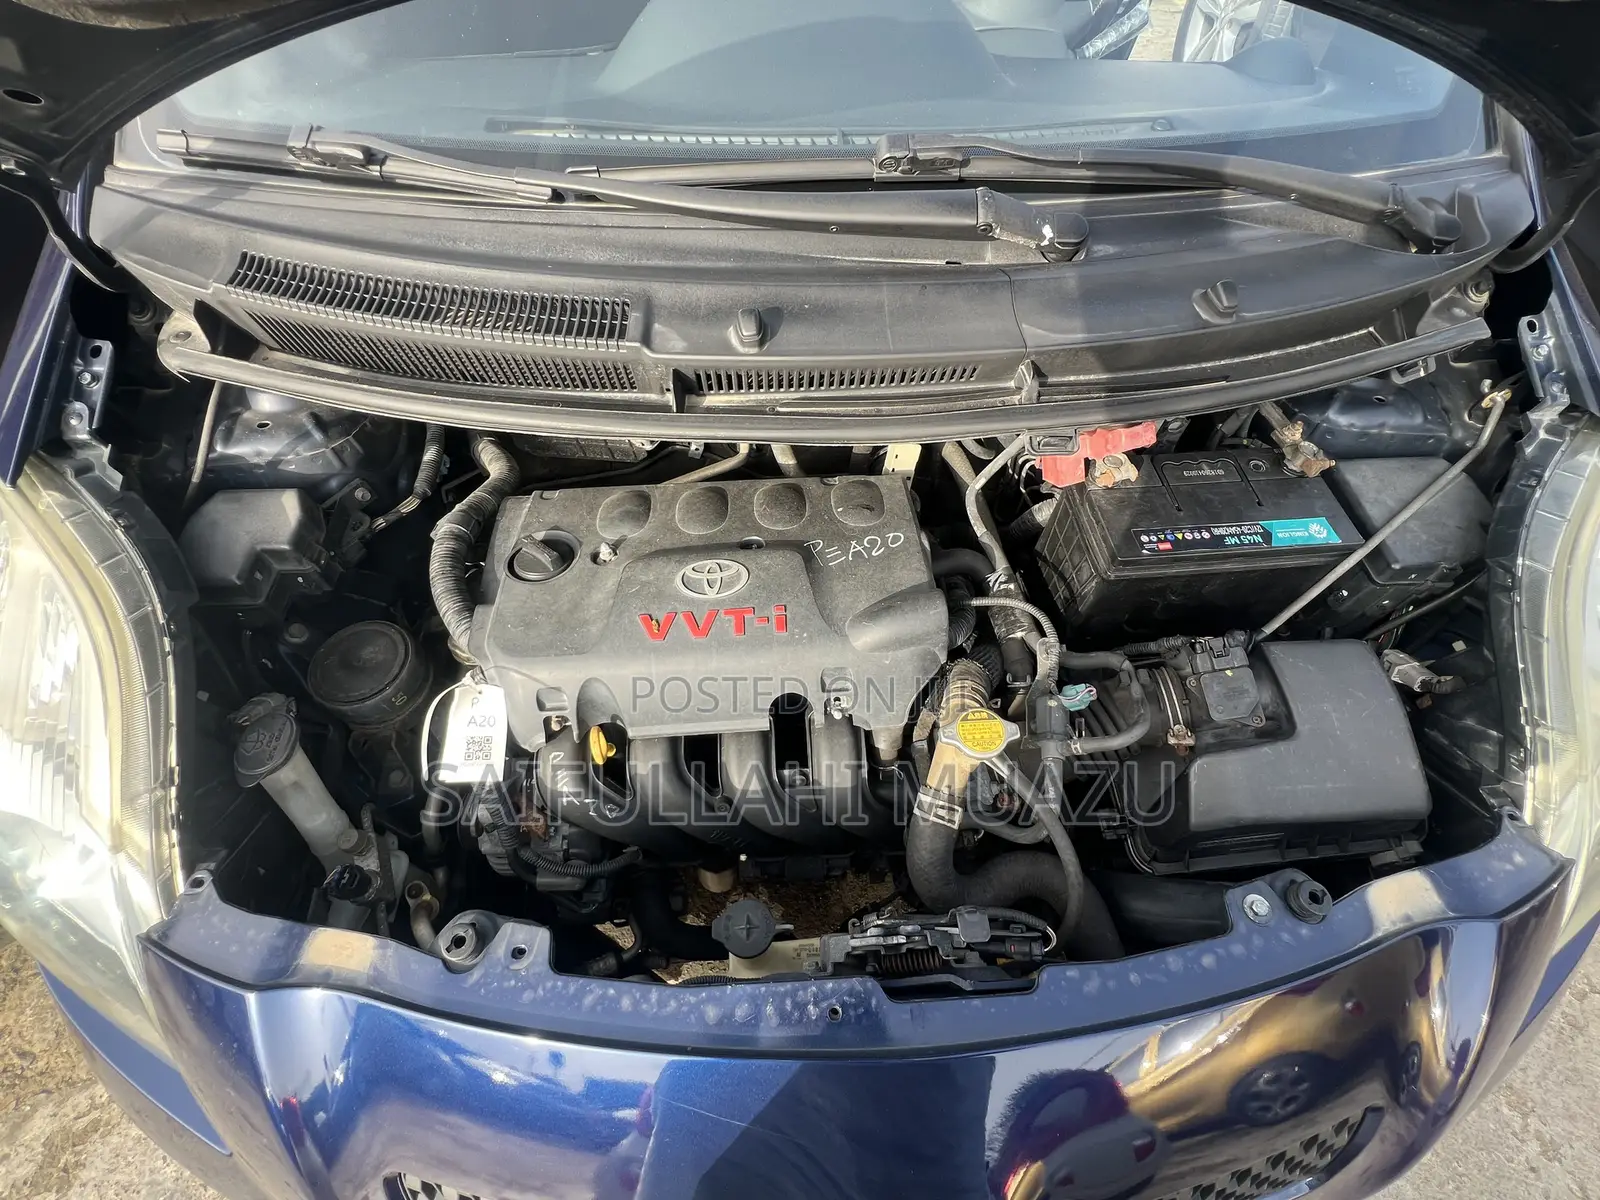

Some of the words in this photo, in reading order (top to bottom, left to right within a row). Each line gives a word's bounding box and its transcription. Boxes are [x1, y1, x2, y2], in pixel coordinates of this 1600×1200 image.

[1223, 535, 1239, 546] MF
[1239, 533, 1264, 545] N45
[637, 603, 790, 642] VVT-i
[467, 714, 497, 729] A20
